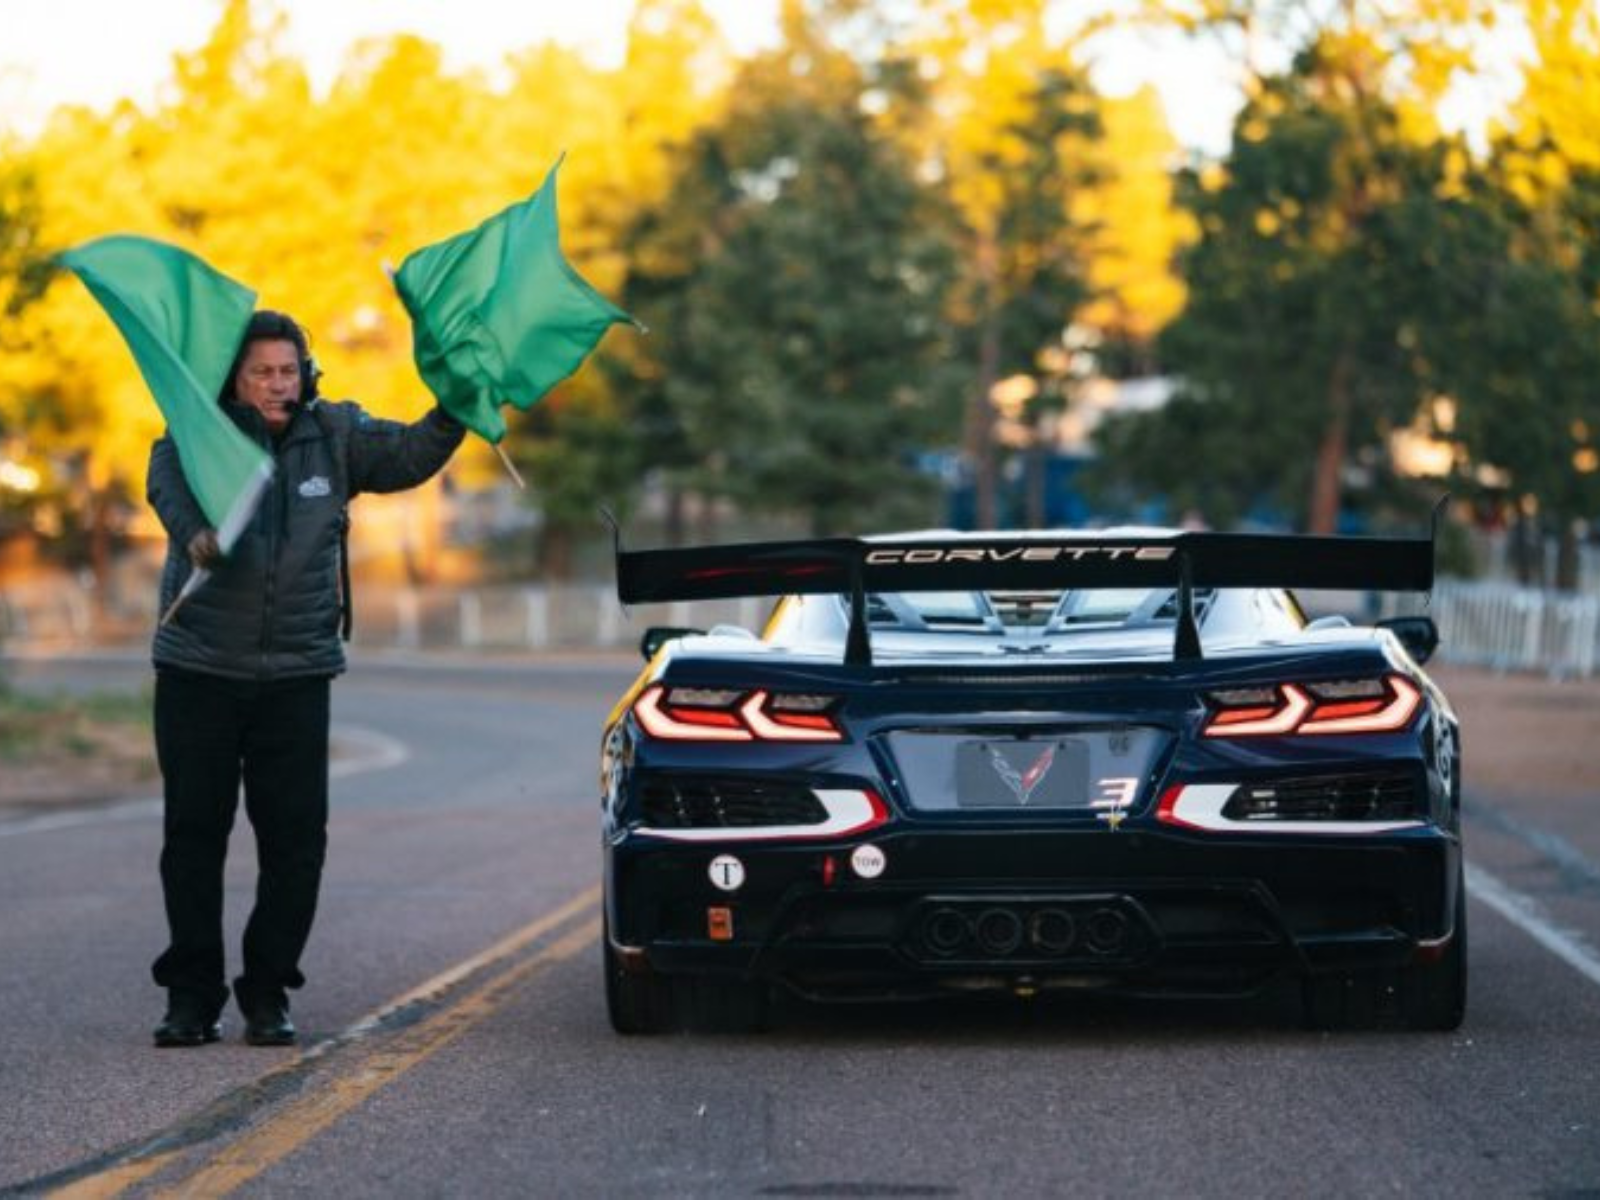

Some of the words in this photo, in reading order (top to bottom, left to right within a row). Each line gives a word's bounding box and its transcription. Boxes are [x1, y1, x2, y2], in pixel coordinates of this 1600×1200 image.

[865, 546, 1175, 564] CORVETTE
[1091, 777, 1138, 808] 3
[854, 854, 882, 868] TOW
[714, 862, 739, 886] T
